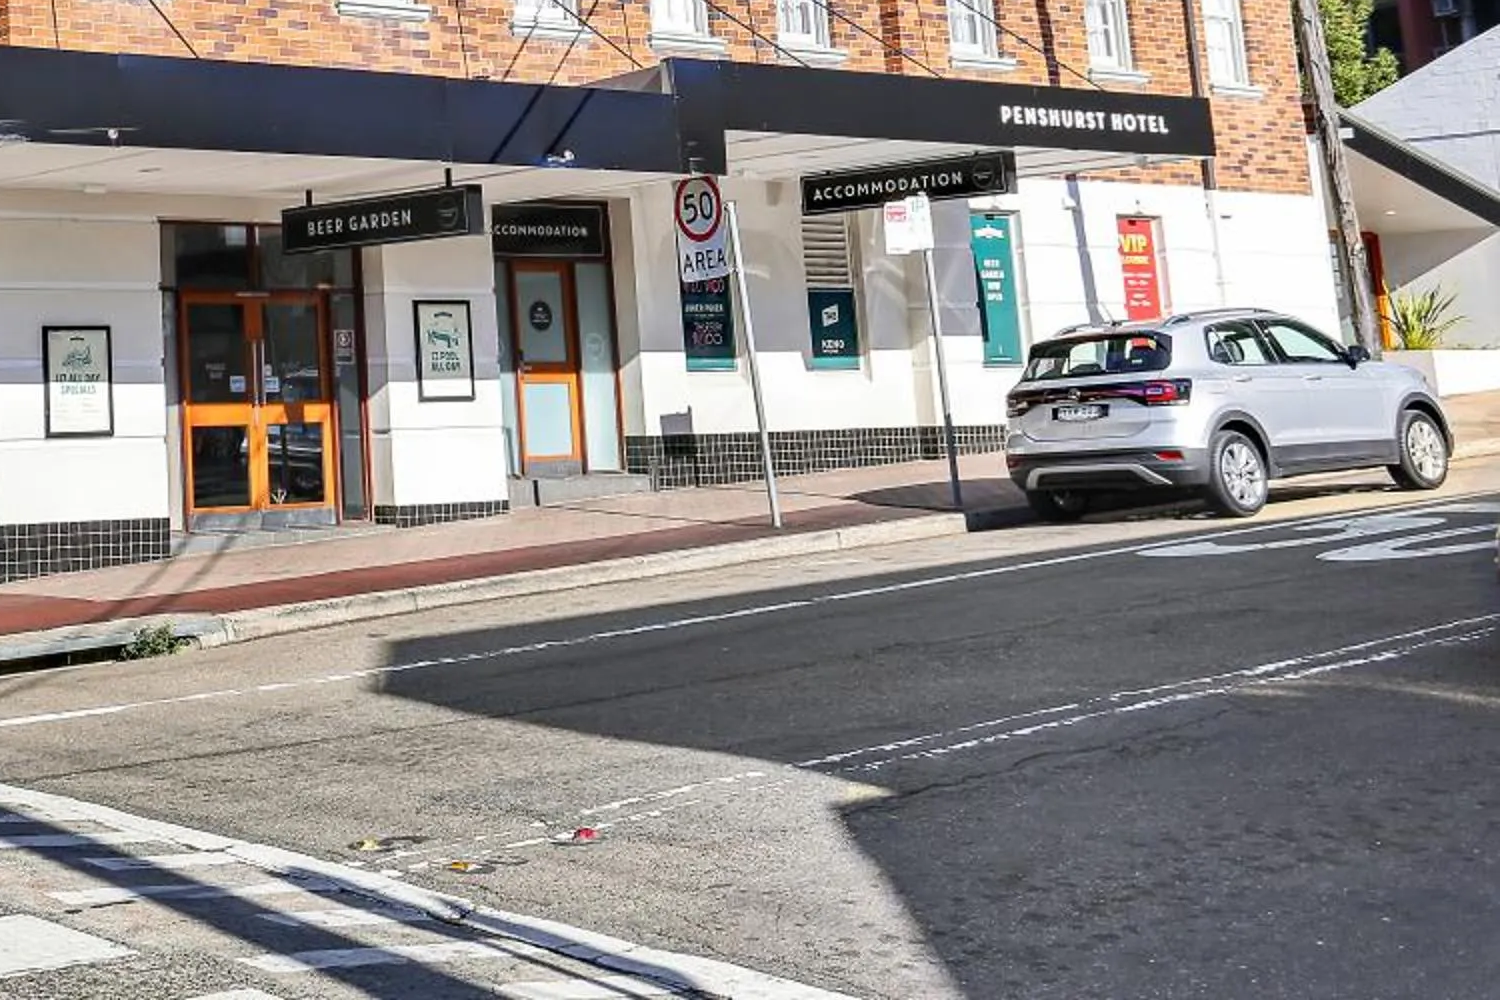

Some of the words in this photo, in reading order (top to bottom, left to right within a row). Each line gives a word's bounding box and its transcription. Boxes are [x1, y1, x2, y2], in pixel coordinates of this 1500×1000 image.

[1000, 105, 1106, 130] PENSHURST
[1110, 113, 1169, 135] HOTEL
[813, 170, 964, 202] ACCOMMODATION
[683, 190, 714, 225] 50
[307, 217, 343, 237] BEER
[349, 209, 412, 232] GARDEN
[490, 222, 589, 237] CCOMMODATION
[1118, 233, 1147, 253] VIP
[683, 247, 727, 273] AREA
